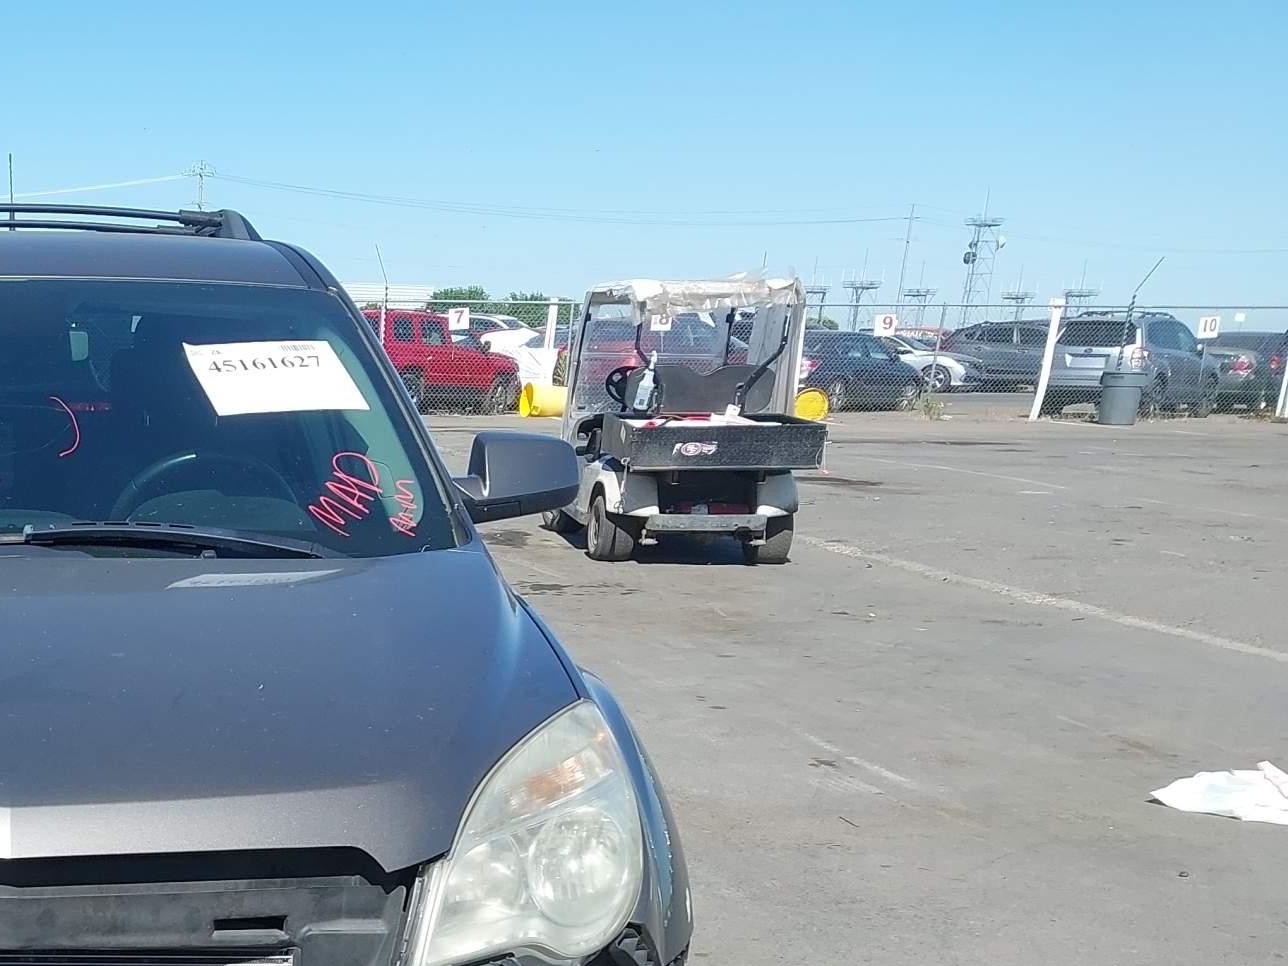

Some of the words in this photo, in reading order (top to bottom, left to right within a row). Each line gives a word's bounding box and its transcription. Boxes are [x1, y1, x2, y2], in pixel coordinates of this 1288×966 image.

[454, 309, 465, 324] 7
[882, 315, 894, 330] 9
[1202, 318, 1217, 333] 10
[207, 355, 320, 373] 45161627
